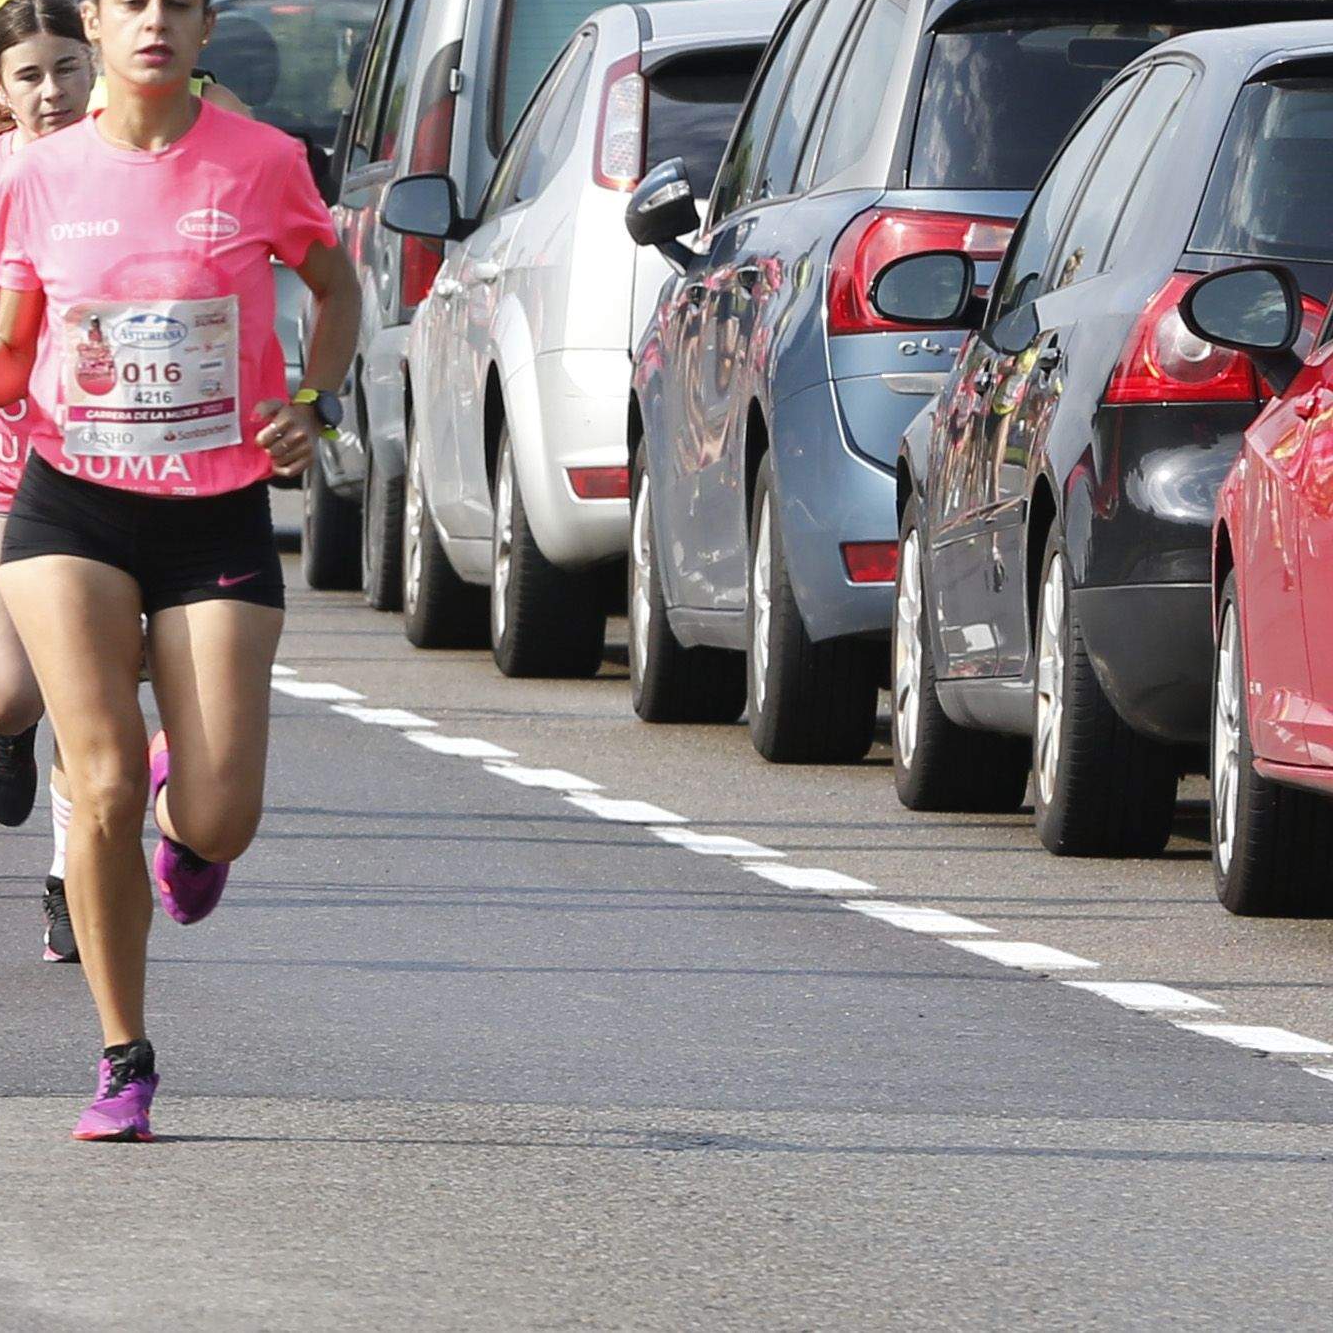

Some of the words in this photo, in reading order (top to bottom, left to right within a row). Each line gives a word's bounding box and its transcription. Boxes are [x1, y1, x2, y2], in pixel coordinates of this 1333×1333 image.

[50, 219, 120, 242] OYSHO
[122, 362, 182, 384] 016
[134, 391, 173, 405] 4216
